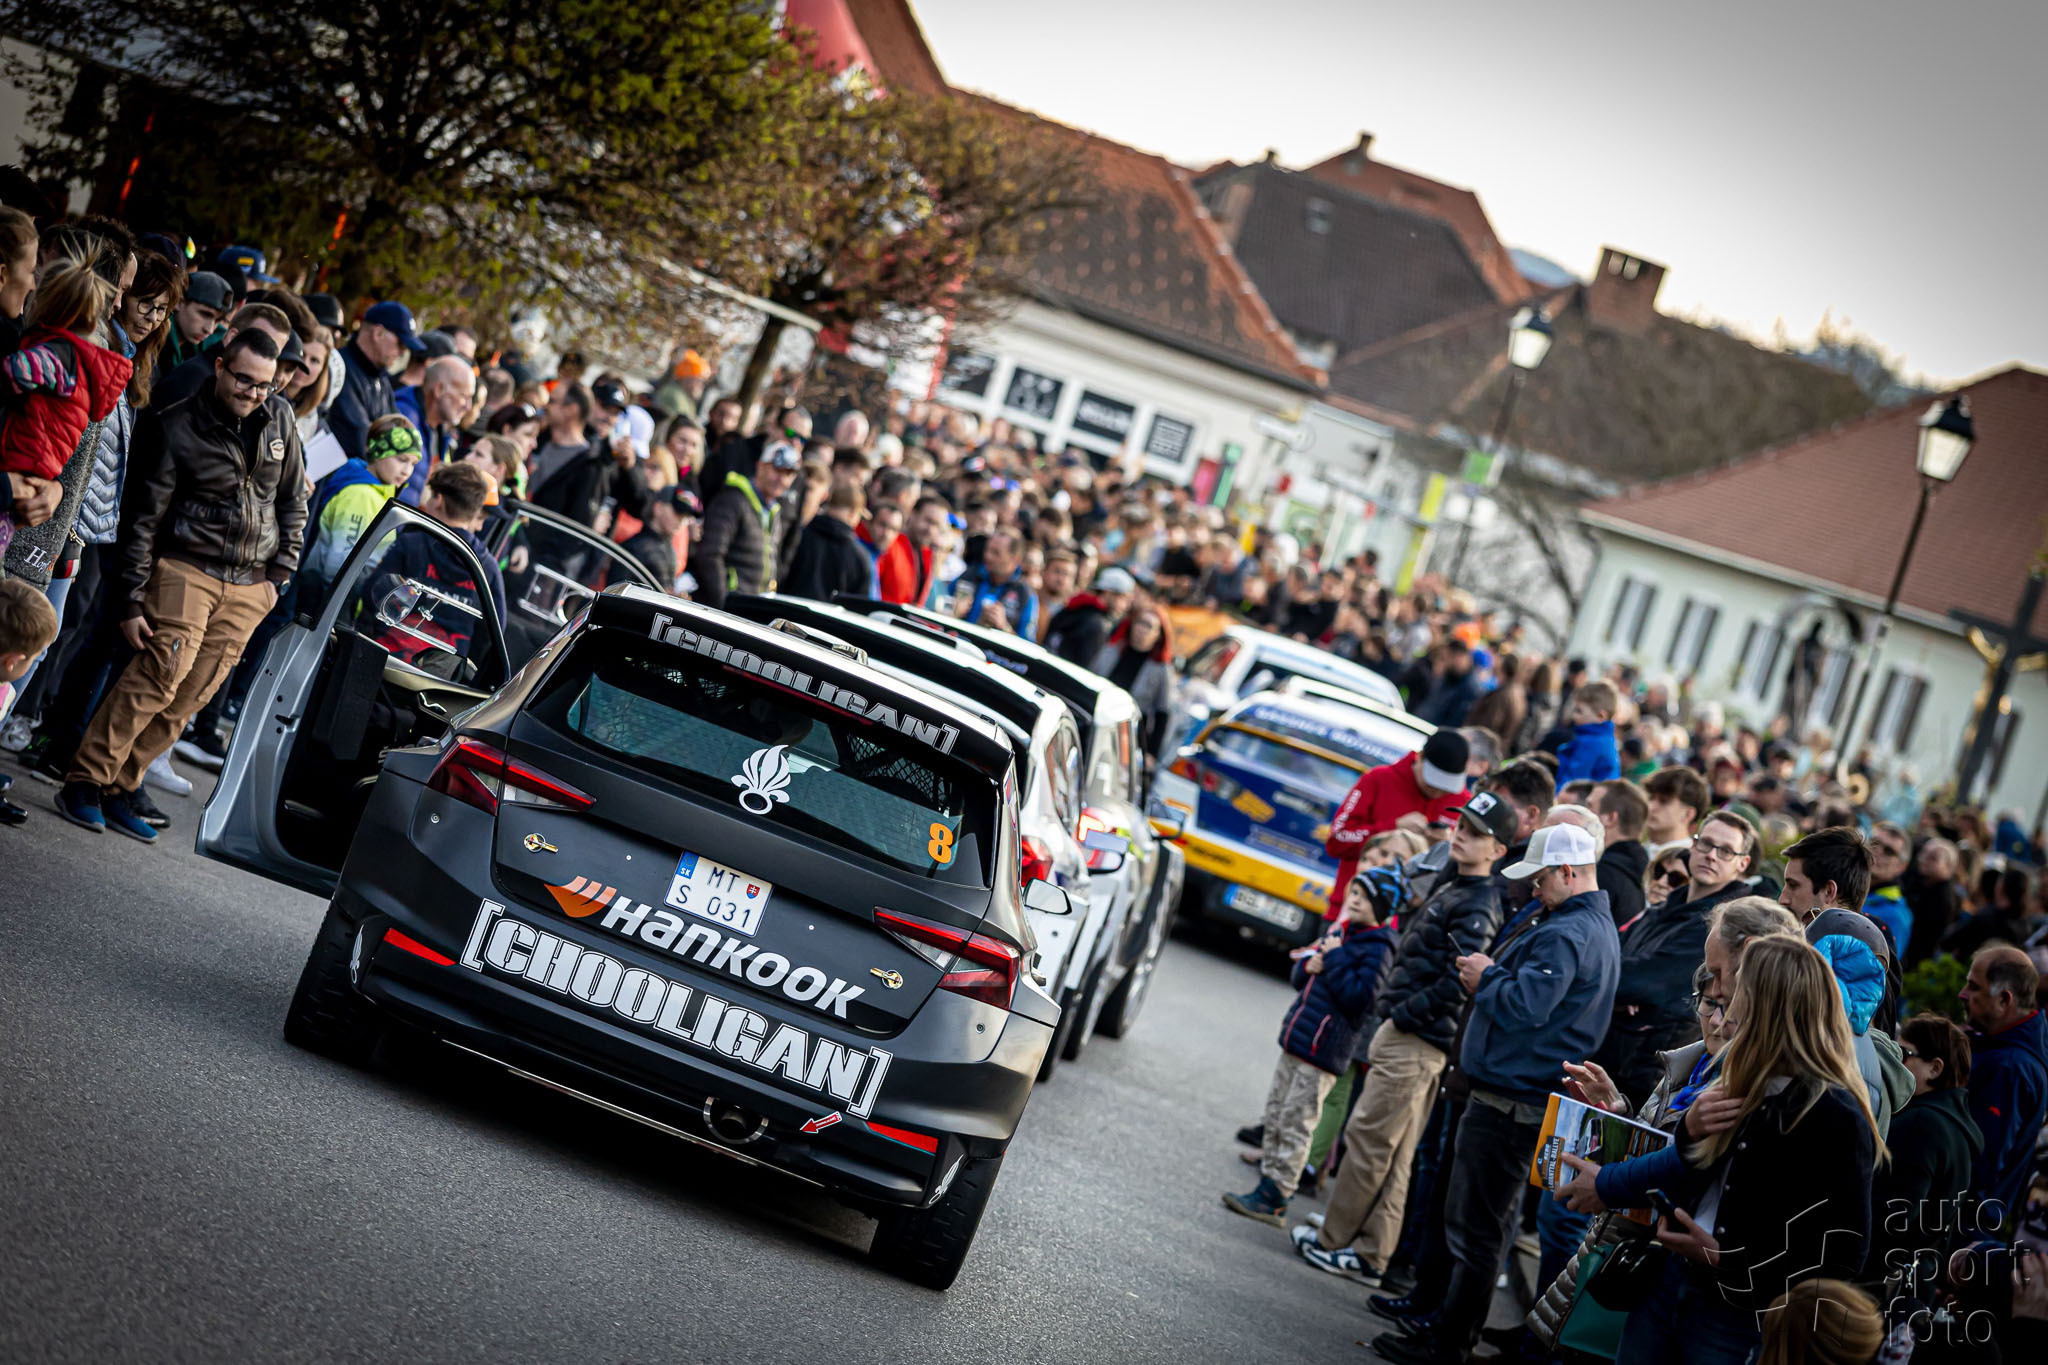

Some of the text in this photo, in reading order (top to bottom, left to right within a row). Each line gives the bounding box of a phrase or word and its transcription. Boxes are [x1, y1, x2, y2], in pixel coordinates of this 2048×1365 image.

[928, 822, 953, 864] 8
[680, 867, 692, 877] SK
[707, 866, 741, 893] MT
[676, 884, 751, 928] S 031
